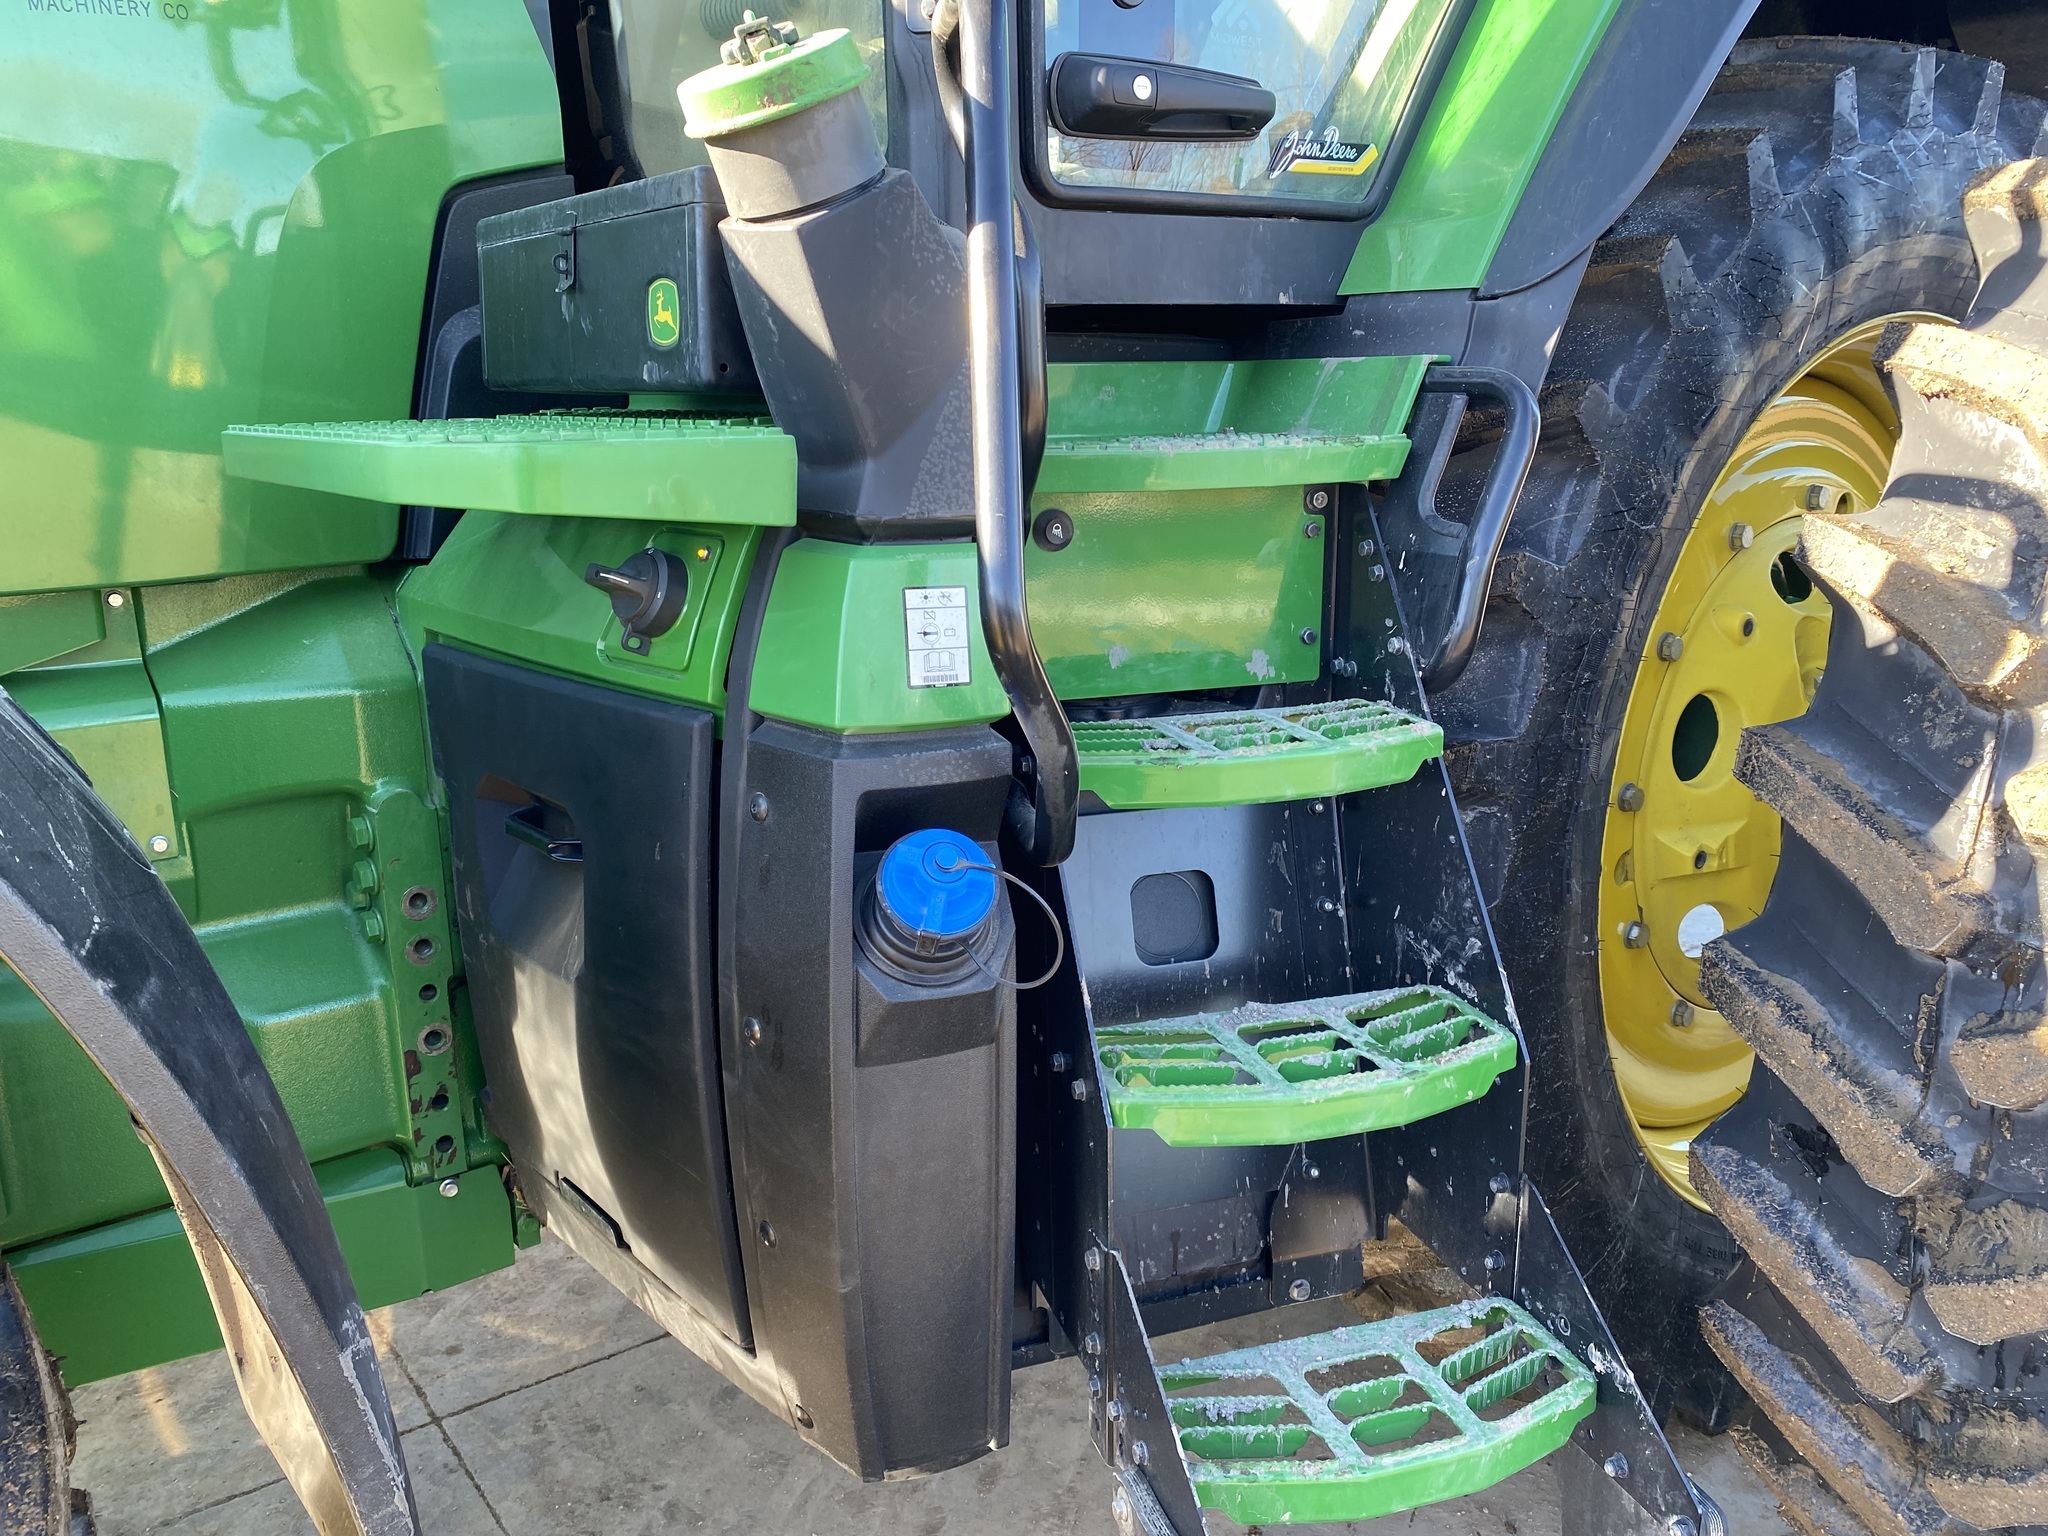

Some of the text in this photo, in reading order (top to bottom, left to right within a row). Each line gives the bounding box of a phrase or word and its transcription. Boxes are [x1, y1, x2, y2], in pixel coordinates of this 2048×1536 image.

[28, 0, 189, 20] MACHINERY CO
[1210, 31, 1262, 48] MIDWEST
[1269, 125, 1357, 180] John Deere
